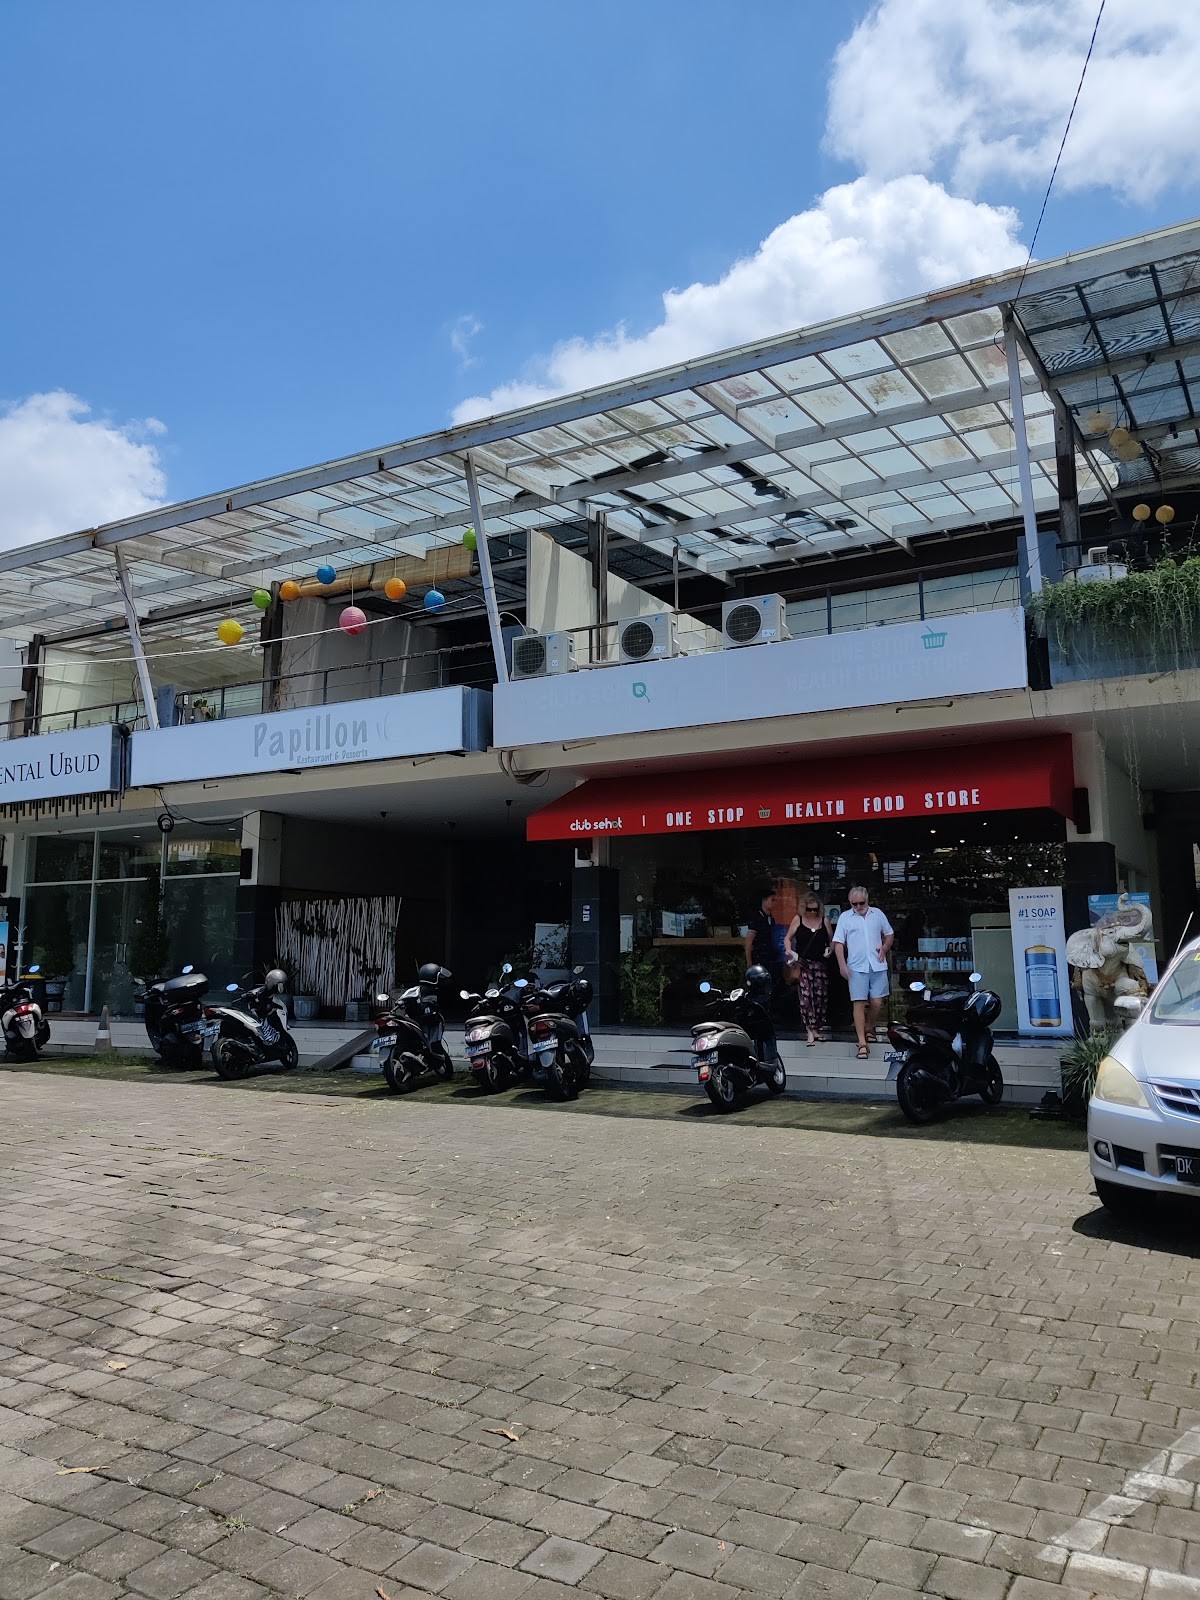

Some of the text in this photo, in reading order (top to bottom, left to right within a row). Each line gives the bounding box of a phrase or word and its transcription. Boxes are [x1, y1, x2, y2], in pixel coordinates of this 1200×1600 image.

[253, 714, 368, 761] Papillon
[296, 753, 331, 764] Restaurant
[342, 749, 368, 759] Desserts
[666, 811, 692, 827] ONE
[707, 807, 744, 824] STOP
[785, 800, 844, 818] HEALTH
[863, 795, 904, 813] FOOD
[924, 788, 980, 809] STORE
[1018, 907, 1056, 918] #1 SOAP
[1177, 1157, 1194, 1175] DK
